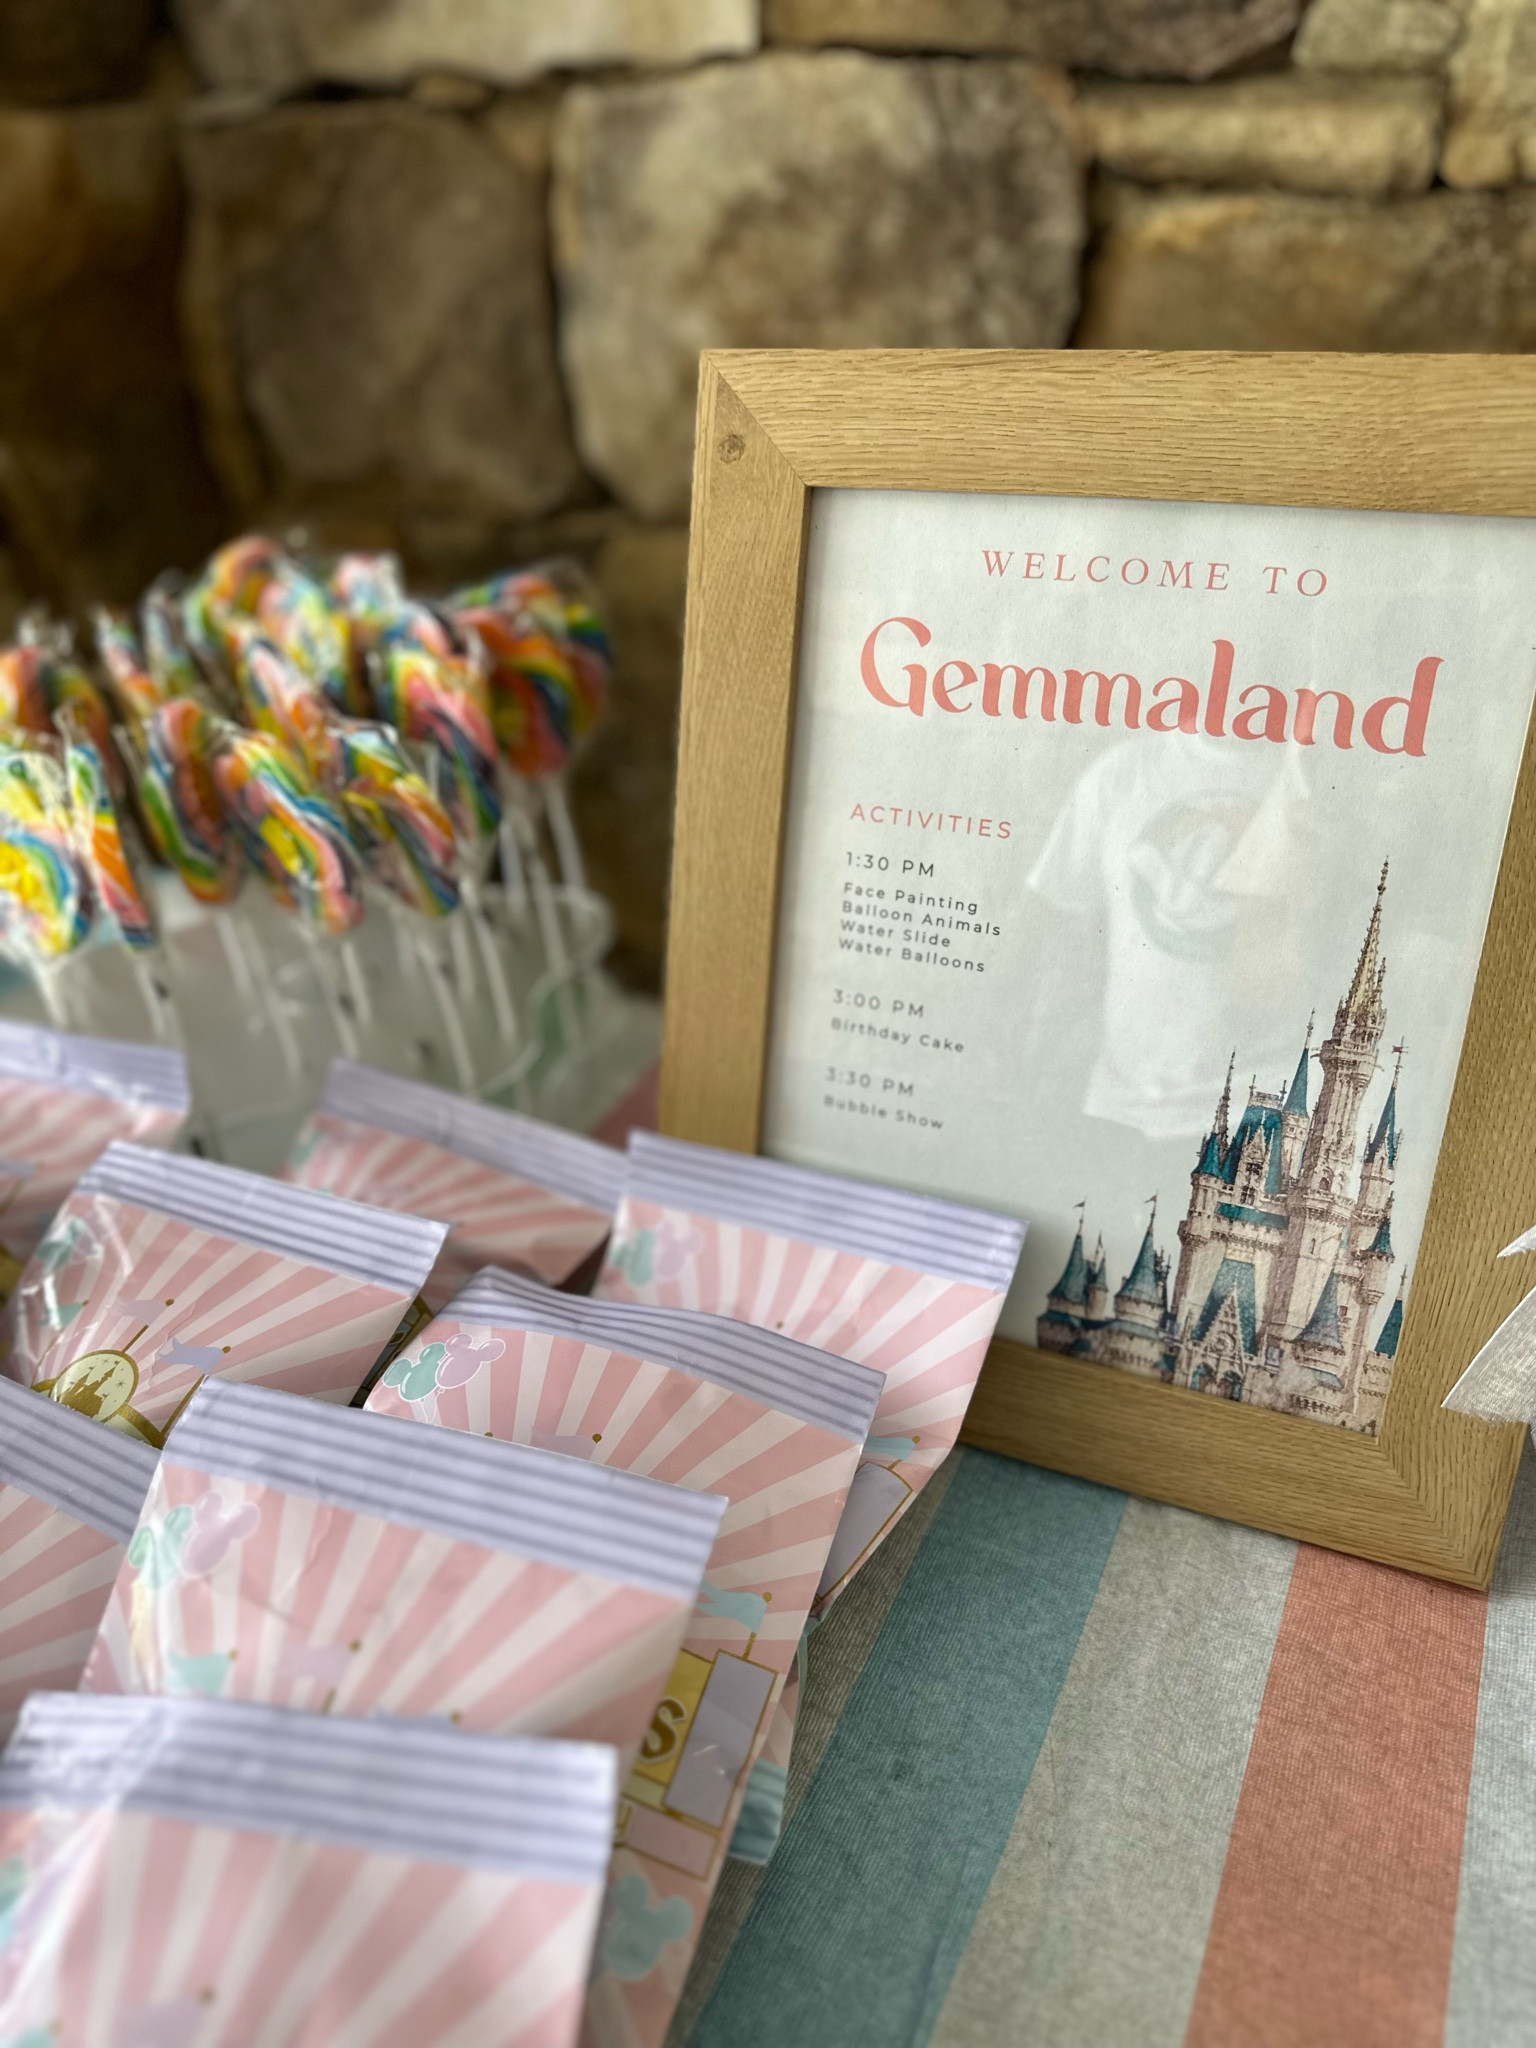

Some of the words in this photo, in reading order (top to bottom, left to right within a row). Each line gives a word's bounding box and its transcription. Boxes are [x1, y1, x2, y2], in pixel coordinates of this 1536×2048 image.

[982, 549, 1230, 591] WELCOME
[1263, 566, 1329, 597] TO
[860, 617, 1445, 757] Gemmaland
[850, 803, 1012, 839] ACTIVITIES
[846, 851, 889, 871] 1:30
[902, 860, 934, 878] PM
[844, 882, 885, 899] Face
[895, 889, 978, 915] Painting
[840, 919, 894, 938] Water
[902, 929, 951, 948] Slide
[842, 900, 913, 922] Balloon
[921, 913, 1001, 936] Animals
[838, 937, 893, 957] Water
[901, 948, 985, 972] Balloons
[832, 989, 881, 1010] 3:00
[892, 1000, 924, 1018] PM
[830, 1017, 911, 1045] Birthday
[919, 1034, 964, 1053] Cake
[825, 1066, 871, 1088] 3:30
[882, 1078, 914, 1097] PM
[822, 1094, 887, 1118] Bubble
[895, 1109, 944, 1129] Show
